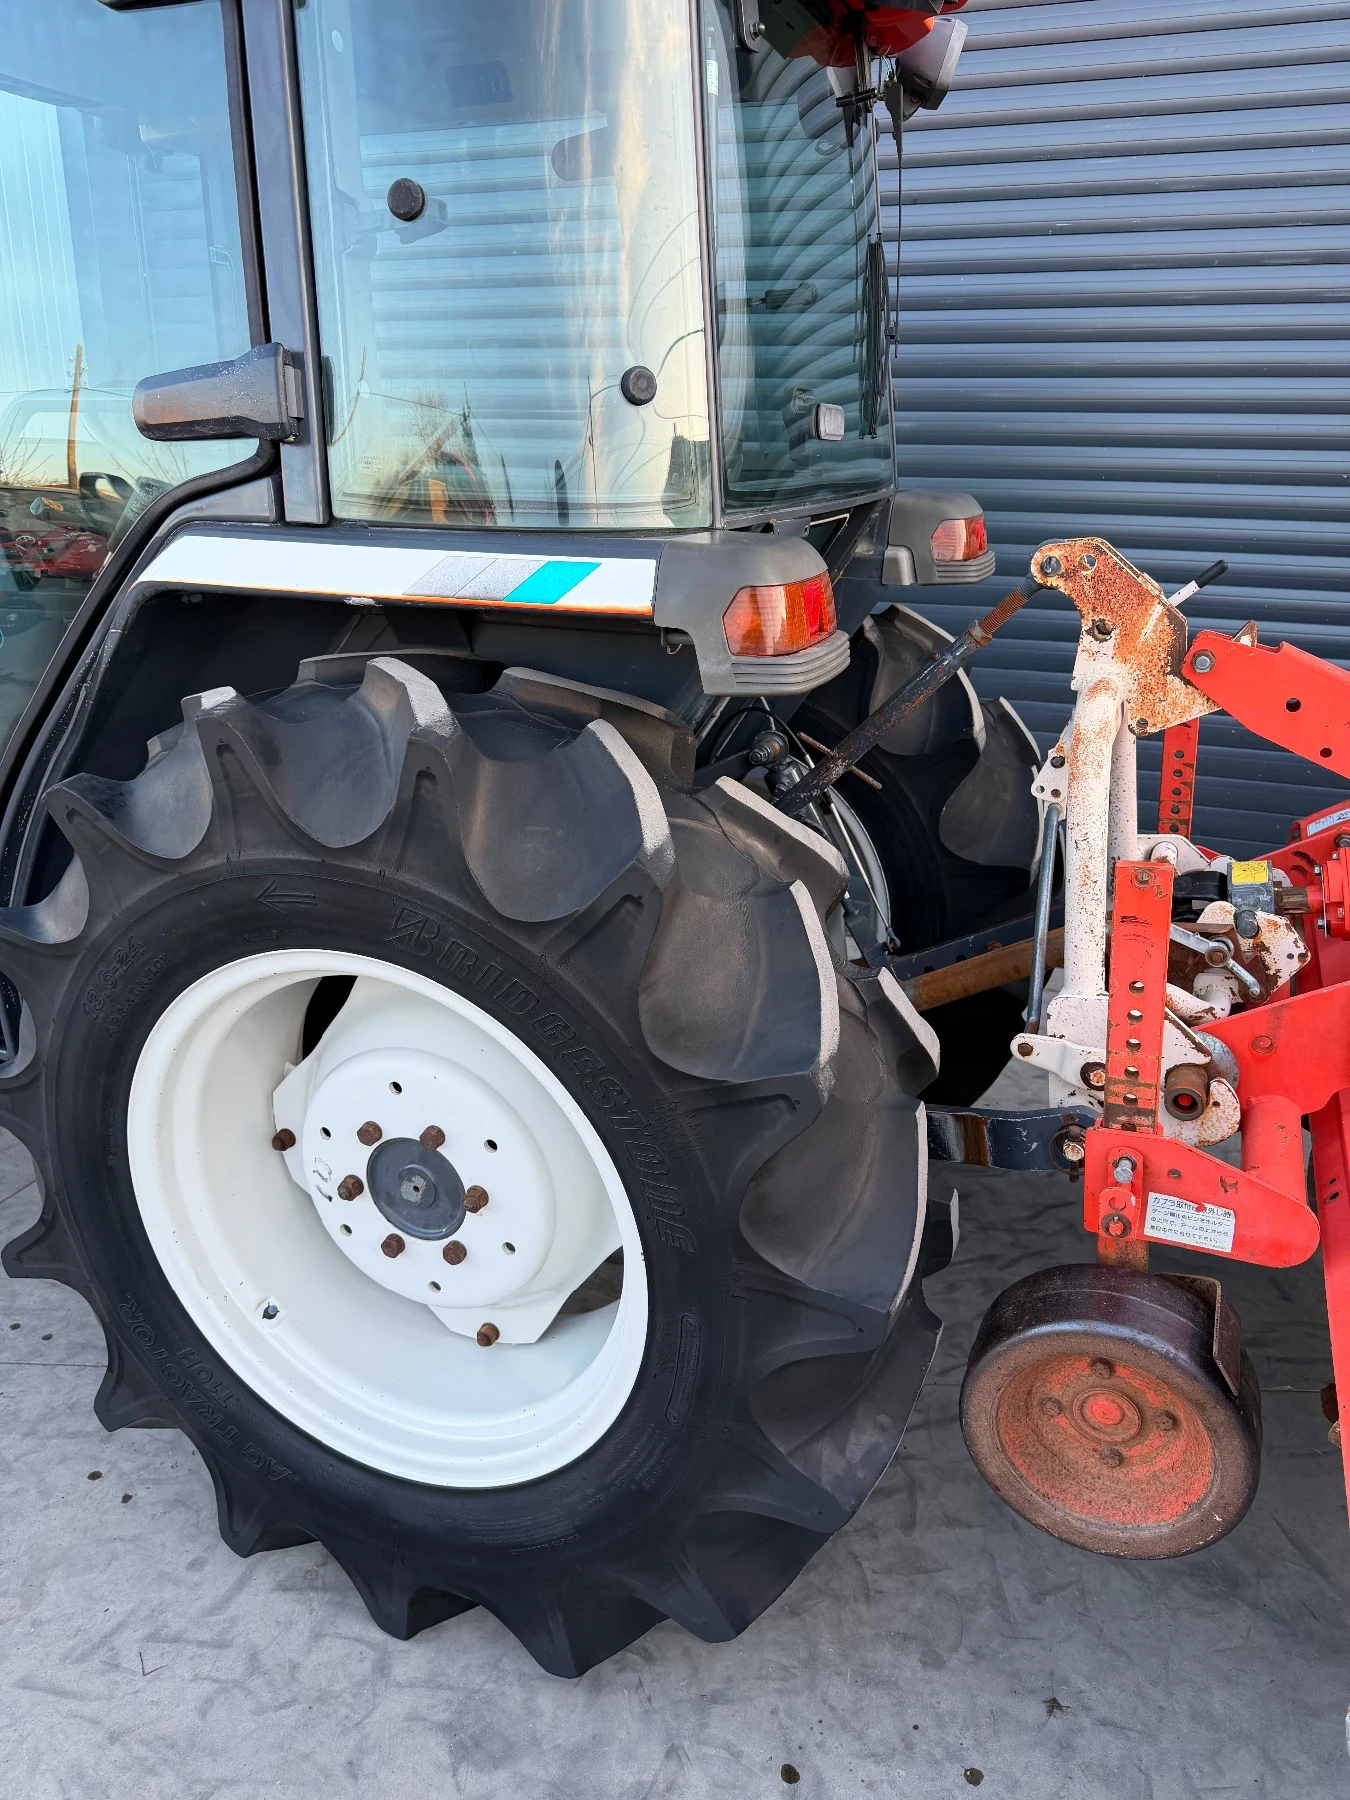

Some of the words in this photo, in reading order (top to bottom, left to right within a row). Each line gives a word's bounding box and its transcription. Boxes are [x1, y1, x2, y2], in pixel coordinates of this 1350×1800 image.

[83, 934, 146, 1020] 13.6-24
[384, 905, 698, 1255] BRIDGESTONE
[118, 1301, 239, 1447] TRACTOR
[241, 1443, 293, 1483] AG
